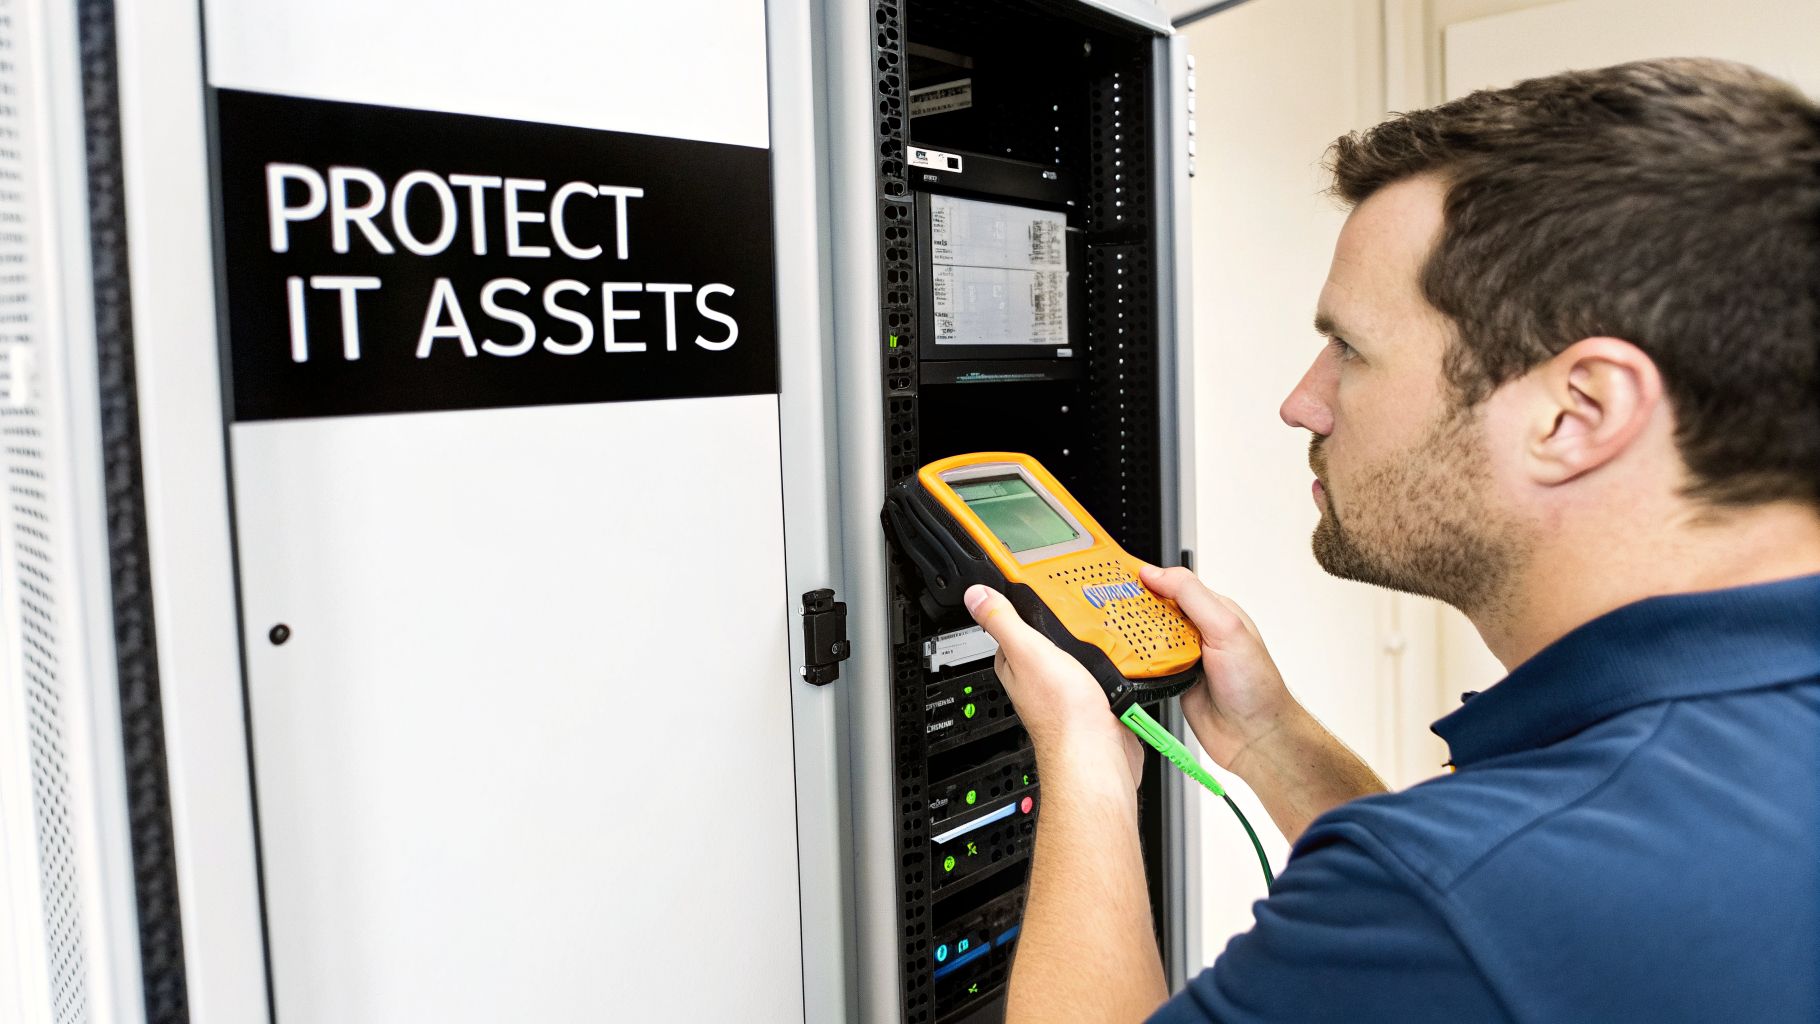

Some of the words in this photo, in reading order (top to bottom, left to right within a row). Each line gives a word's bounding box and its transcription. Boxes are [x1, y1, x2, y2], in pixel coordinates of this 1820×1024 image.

[266, 162, 644, 259] PROTECT
[287, 275, 382, 363] IT
[415, 278, 738, 359] ASSETS
